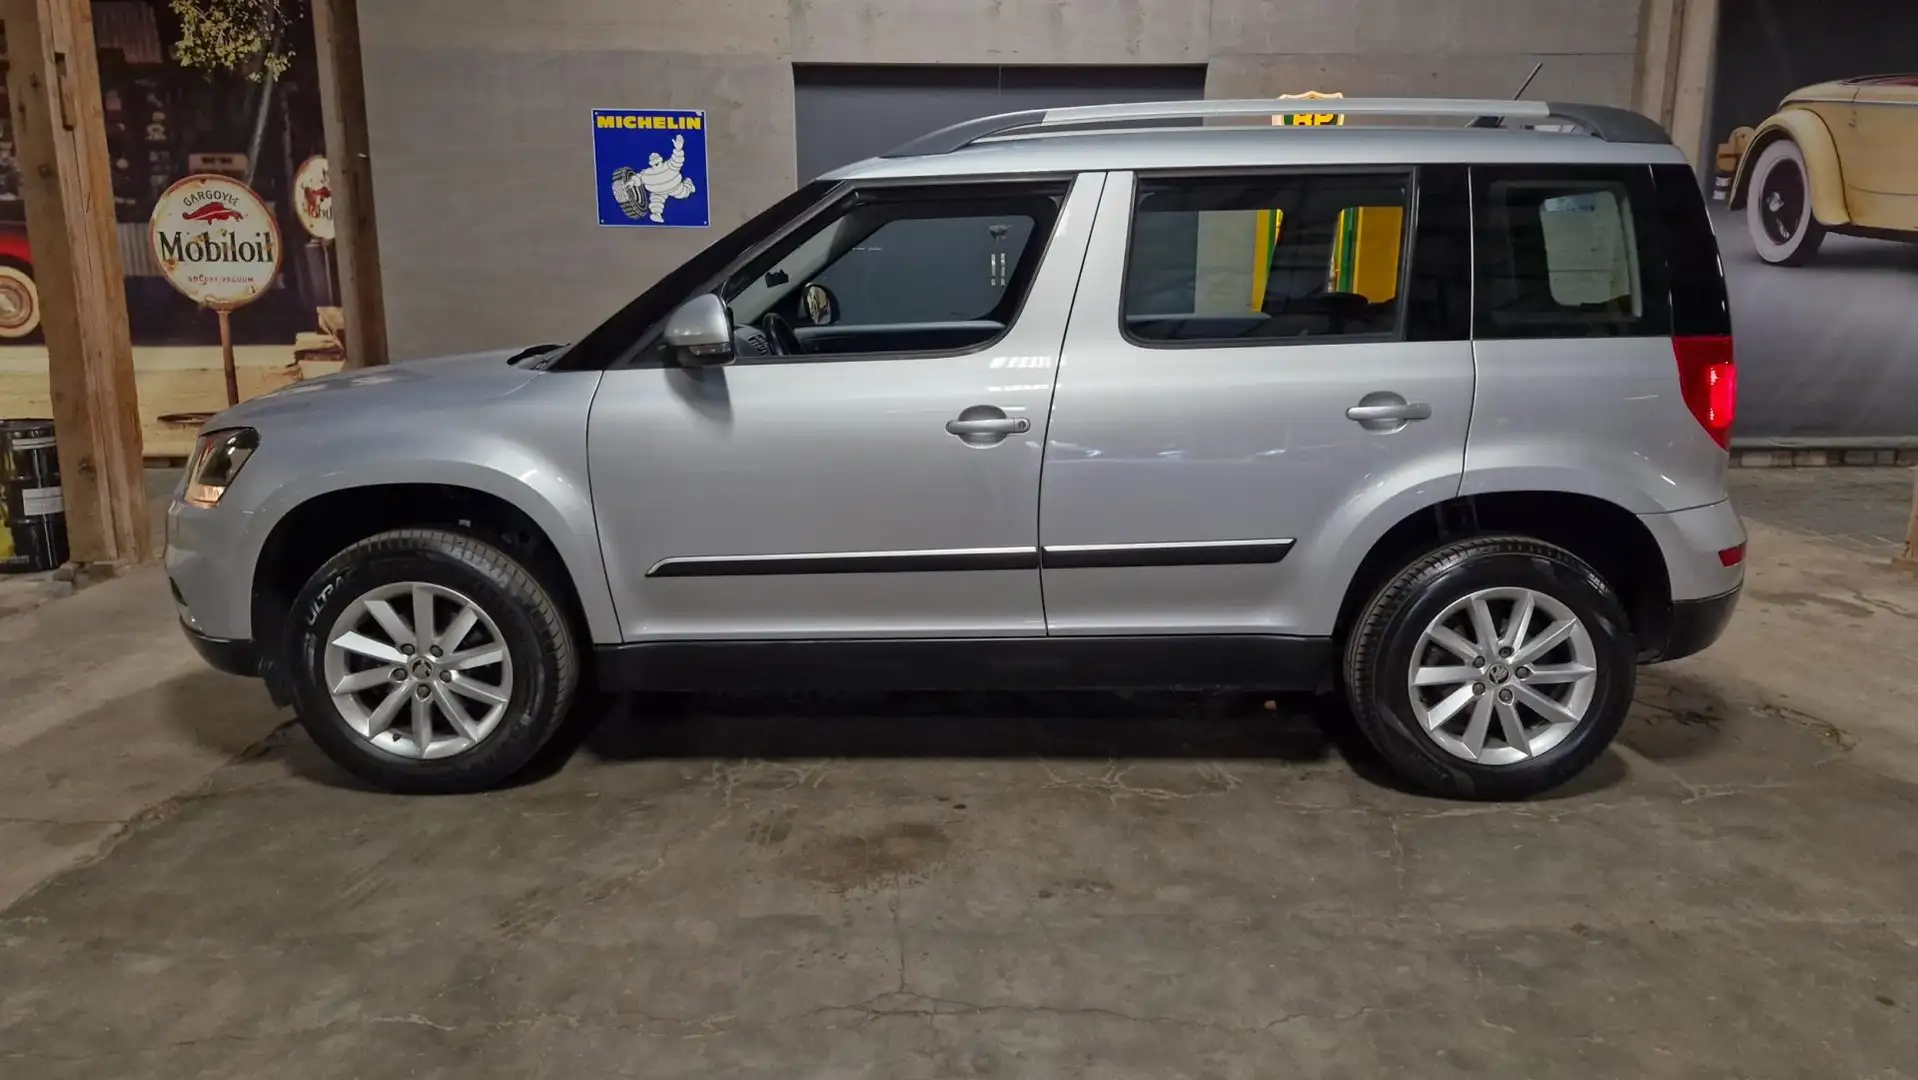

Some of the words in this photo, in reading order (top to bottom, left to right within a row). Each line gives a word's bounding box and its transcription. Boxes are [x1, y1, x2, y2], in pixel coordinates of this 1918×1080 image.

[597, 116, 701, 130] MICHELIN
[183, 190, 240, 207] GARGOYLE
[158, 231, 274, 263] Mobiloil
